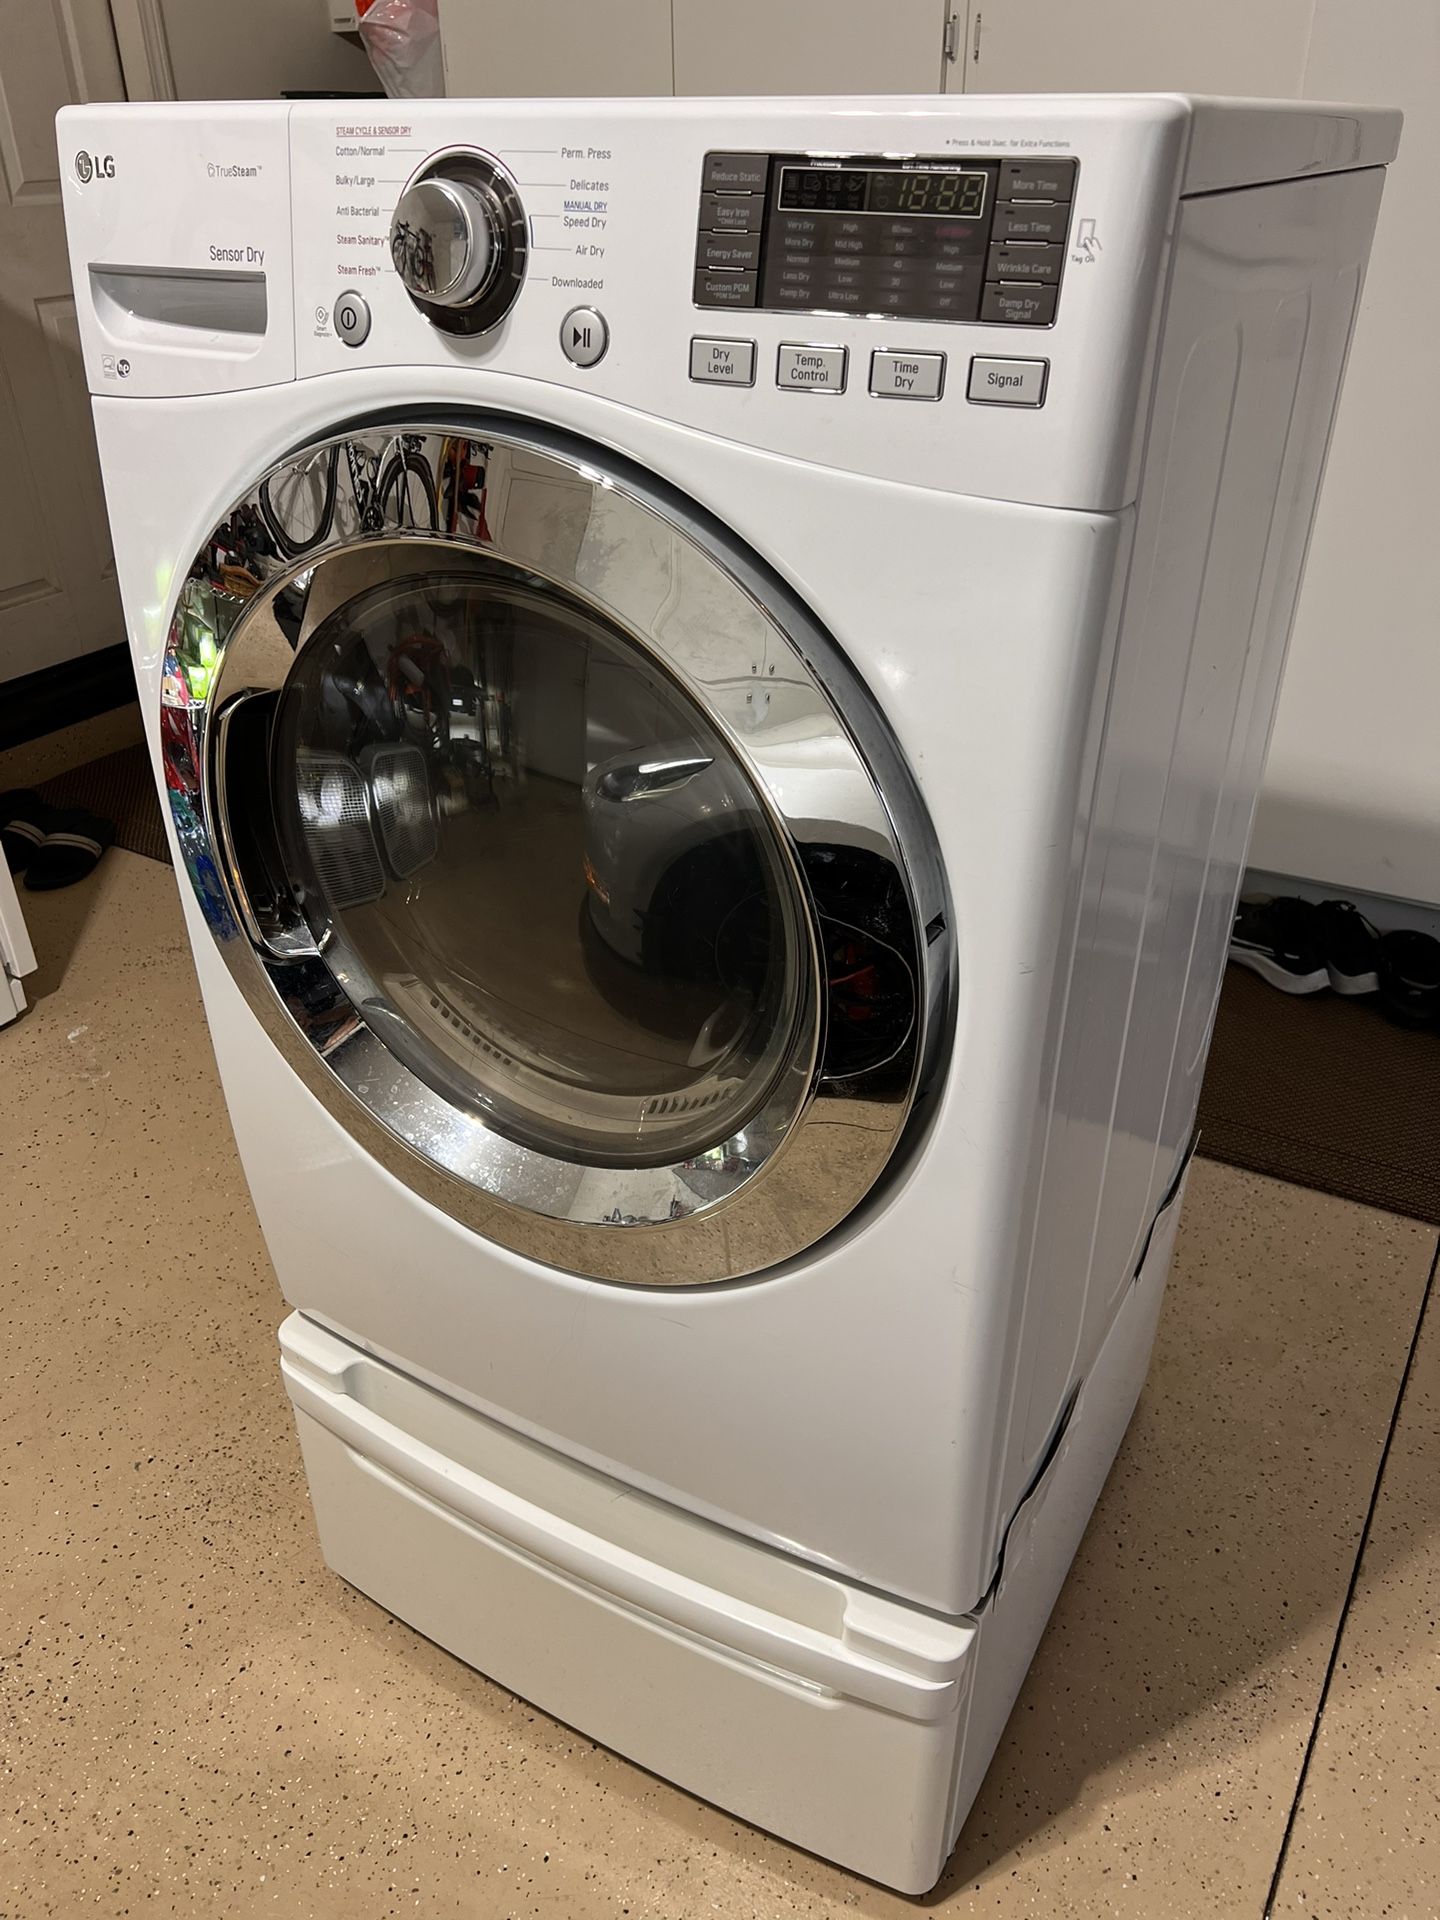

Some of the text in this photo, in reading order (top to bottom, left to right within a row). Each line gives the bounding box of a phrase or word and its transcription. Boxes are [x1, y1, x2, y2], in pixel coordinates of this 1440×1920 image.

[336, 127, 354, 135] STEAM
[355, 126, 372, 135] CYCLE
[378, 126, 399, 135] SENSOR
[400, 126, 412, 134] DRY
[336, 146, 385, 156] Cotton/Normal
[561, 147, 612, 159] Perm. Press
[94, 155, 116, 179] LG
[336, 175, 375, 187] Bulky/Large
[711, 171, 761, 182] Reduce Static
[570, 179, 609, 191] Delicates
[1013, 180, 1058, 191] More Time
[336, 206, 380, 217] Anti Bacterial
[563, 200, 608, 211] MANUAL DRY
[717, 207, 750, 218] Easy Iron
[563, 215, 607, 231] Speed Dry
[1008, 222, 1051, 233] Less Time
[337, 234, 357, 245] Steam
[209, 245, 265, 266] Sensor Dry
[576, 245, 605, 259] Air Dry
[706, 248, 753, 260] Energy Saver
[1071, 254, 1083, 264] Tag
[337, 264, 357, 275] Steam
[997, 263, 1052, 274] Wrinkle Care
[552, 276, 604, 289] Downloaded
[705, 282, 750, 293] Custom PGM
[999, 298, 1040, 311] Damp Dry
[1005, 309, 1032, 320] Signal
[712, 348, 730, 362] Dry
[795, 353, 826, 368] Temp.
[707, 362, 734, 375] Level
[893, 360, 919, 374] Time
[790, 368, 829, 382] Control
[987, 372, 1024, 388] Signal
[894, 375, 915, 391] Dry
